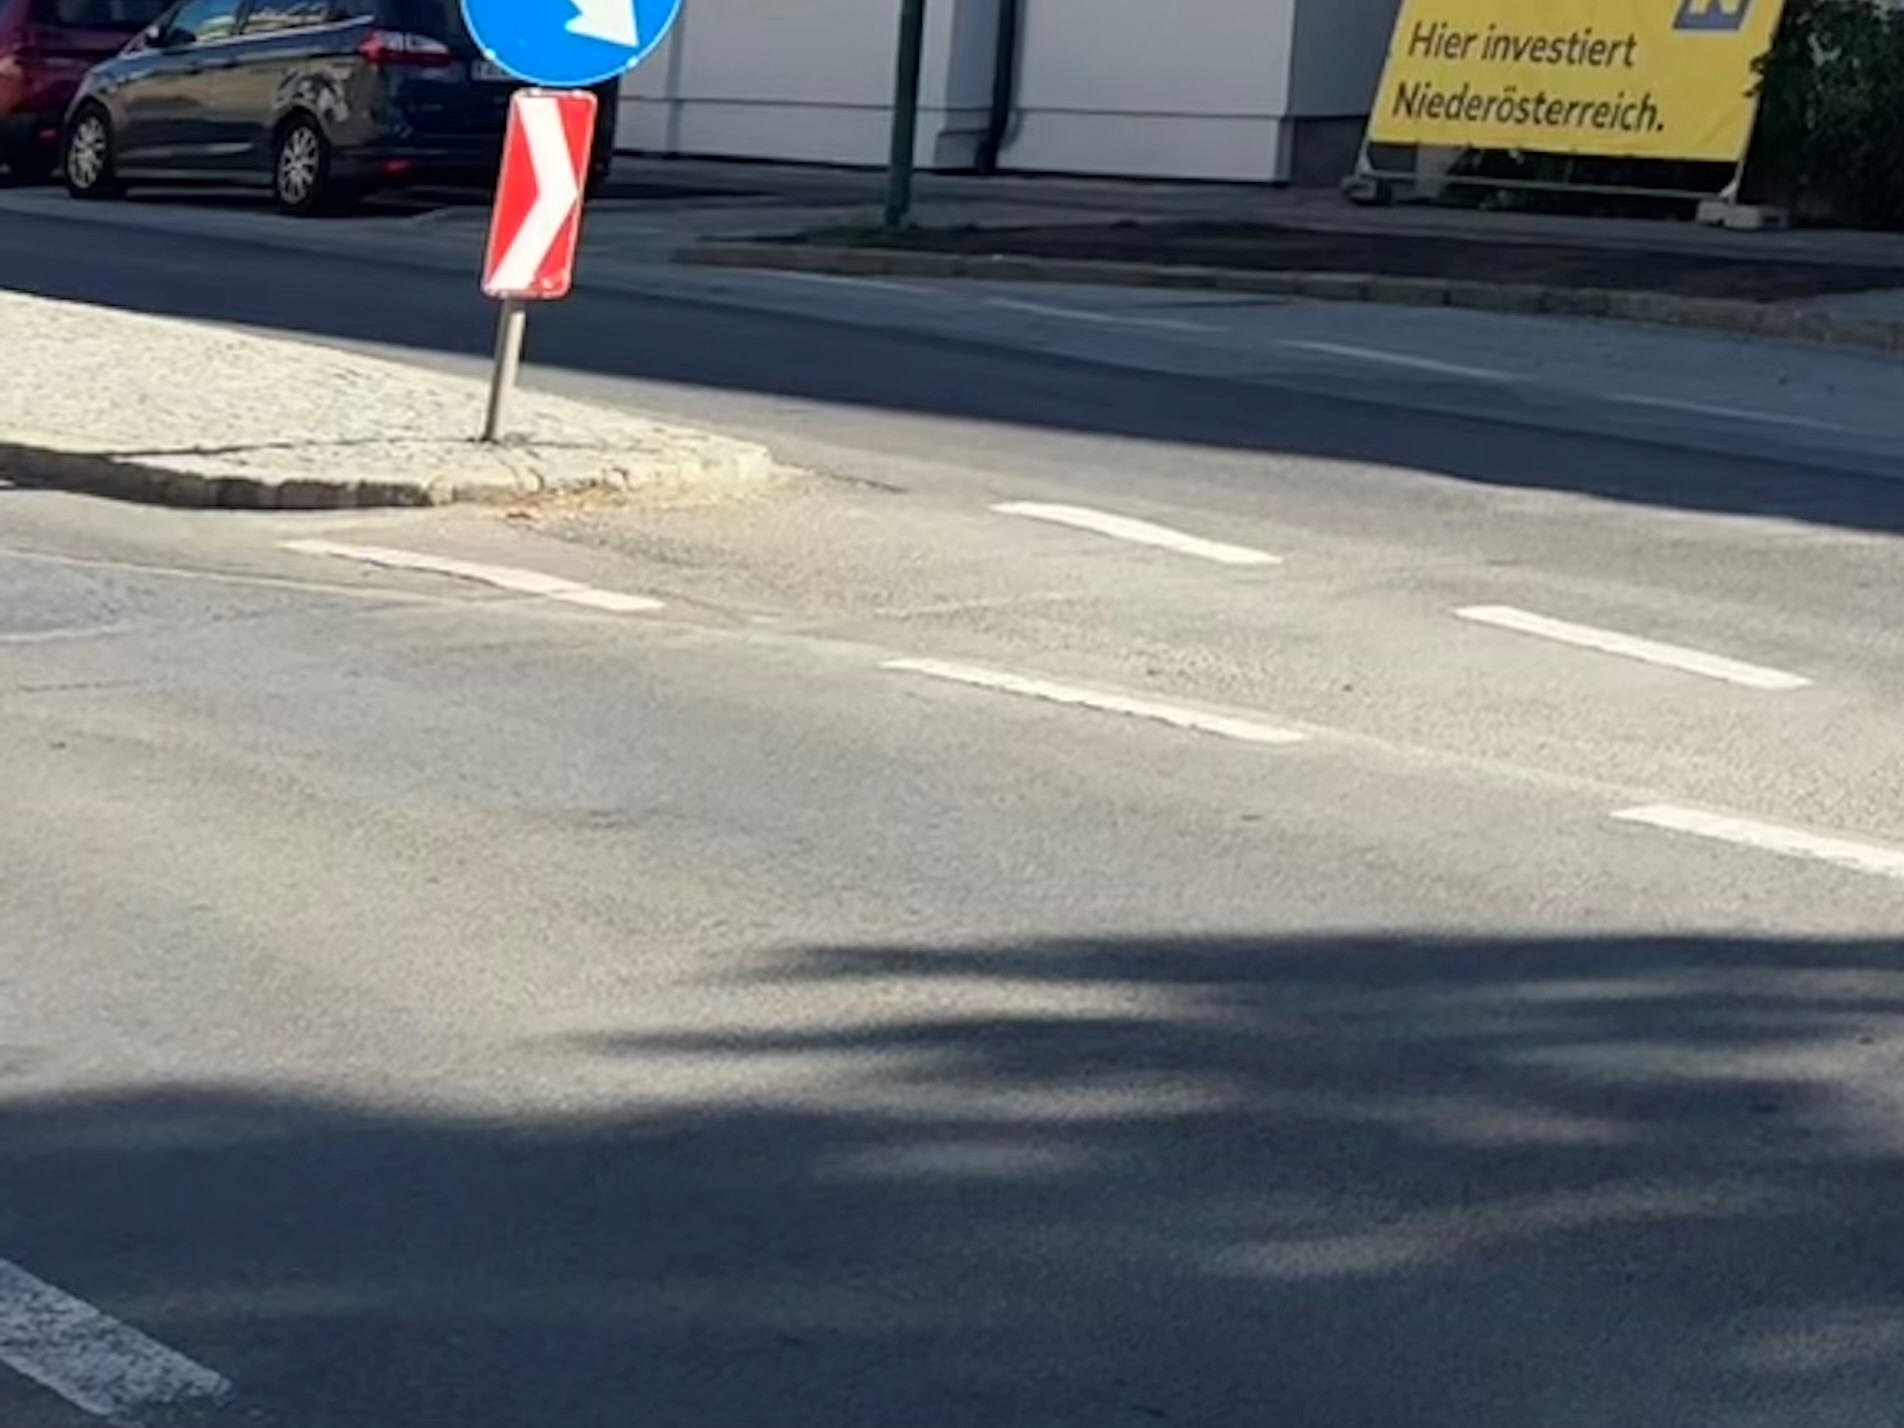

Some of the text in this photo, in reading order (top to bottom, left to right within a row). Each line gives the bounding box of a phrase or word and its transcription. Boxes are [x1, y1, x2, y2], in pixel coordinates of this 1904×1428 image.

[1407, 20, 1638, 67] Hier investiert
[1392, 81, 1664, 132] Niederösterreich.
